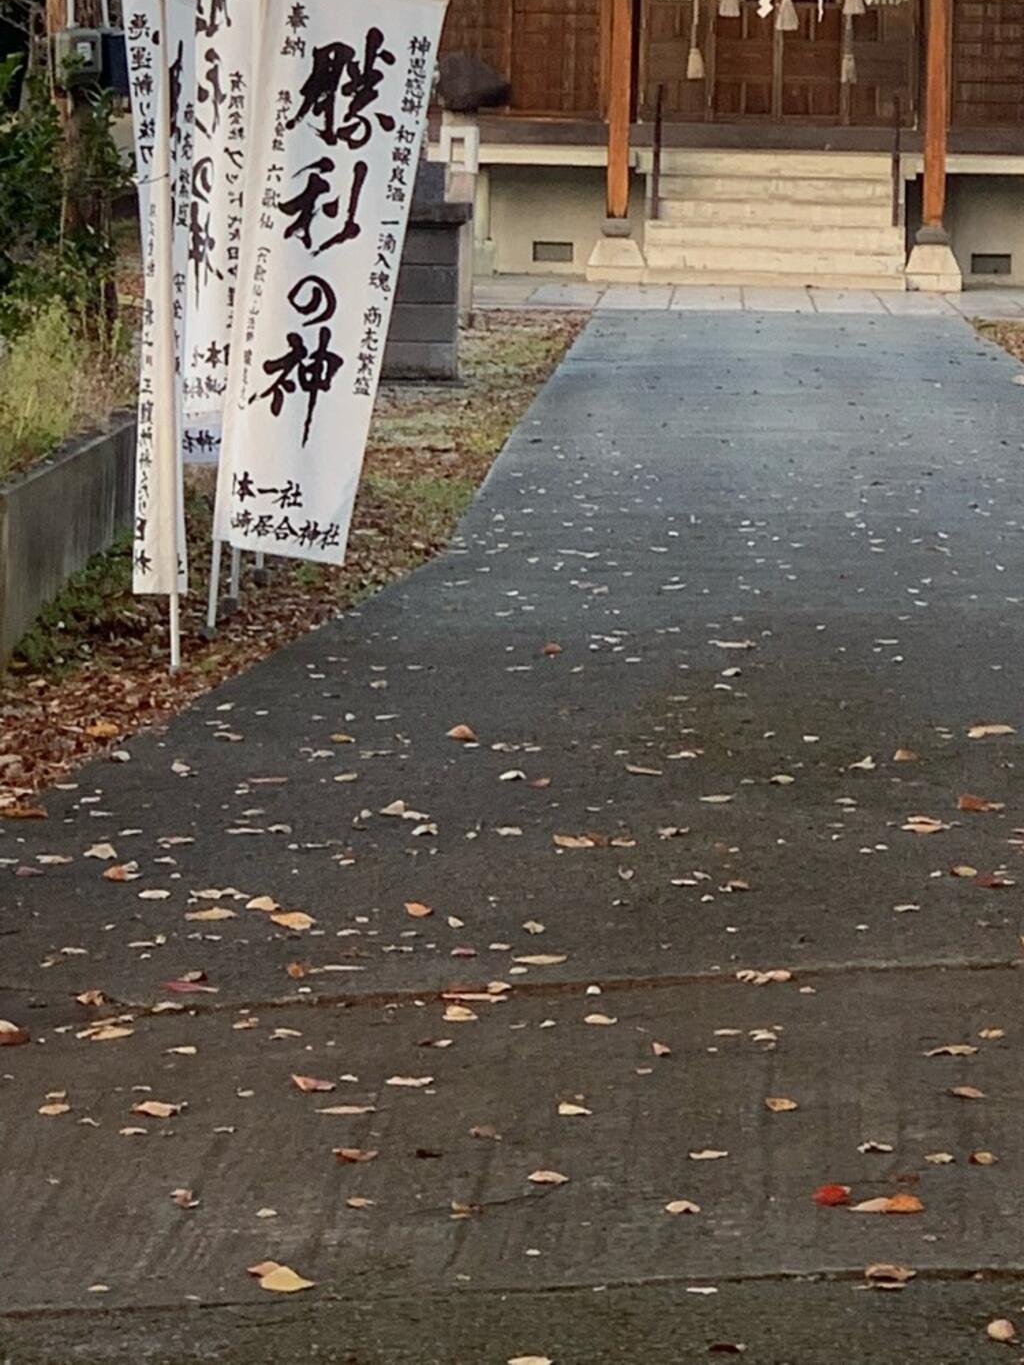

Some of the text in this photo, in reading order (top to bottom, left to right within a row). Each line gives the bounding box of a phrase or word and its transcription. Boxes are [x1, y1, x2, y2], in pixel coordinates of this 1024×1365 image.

[281, 2, 310, 58] 奉納
[271, 89, 294, 152] 株式会社
[249, 26, 397, 449] 勝利の神
[231, 471, 303, 509] 本一社
